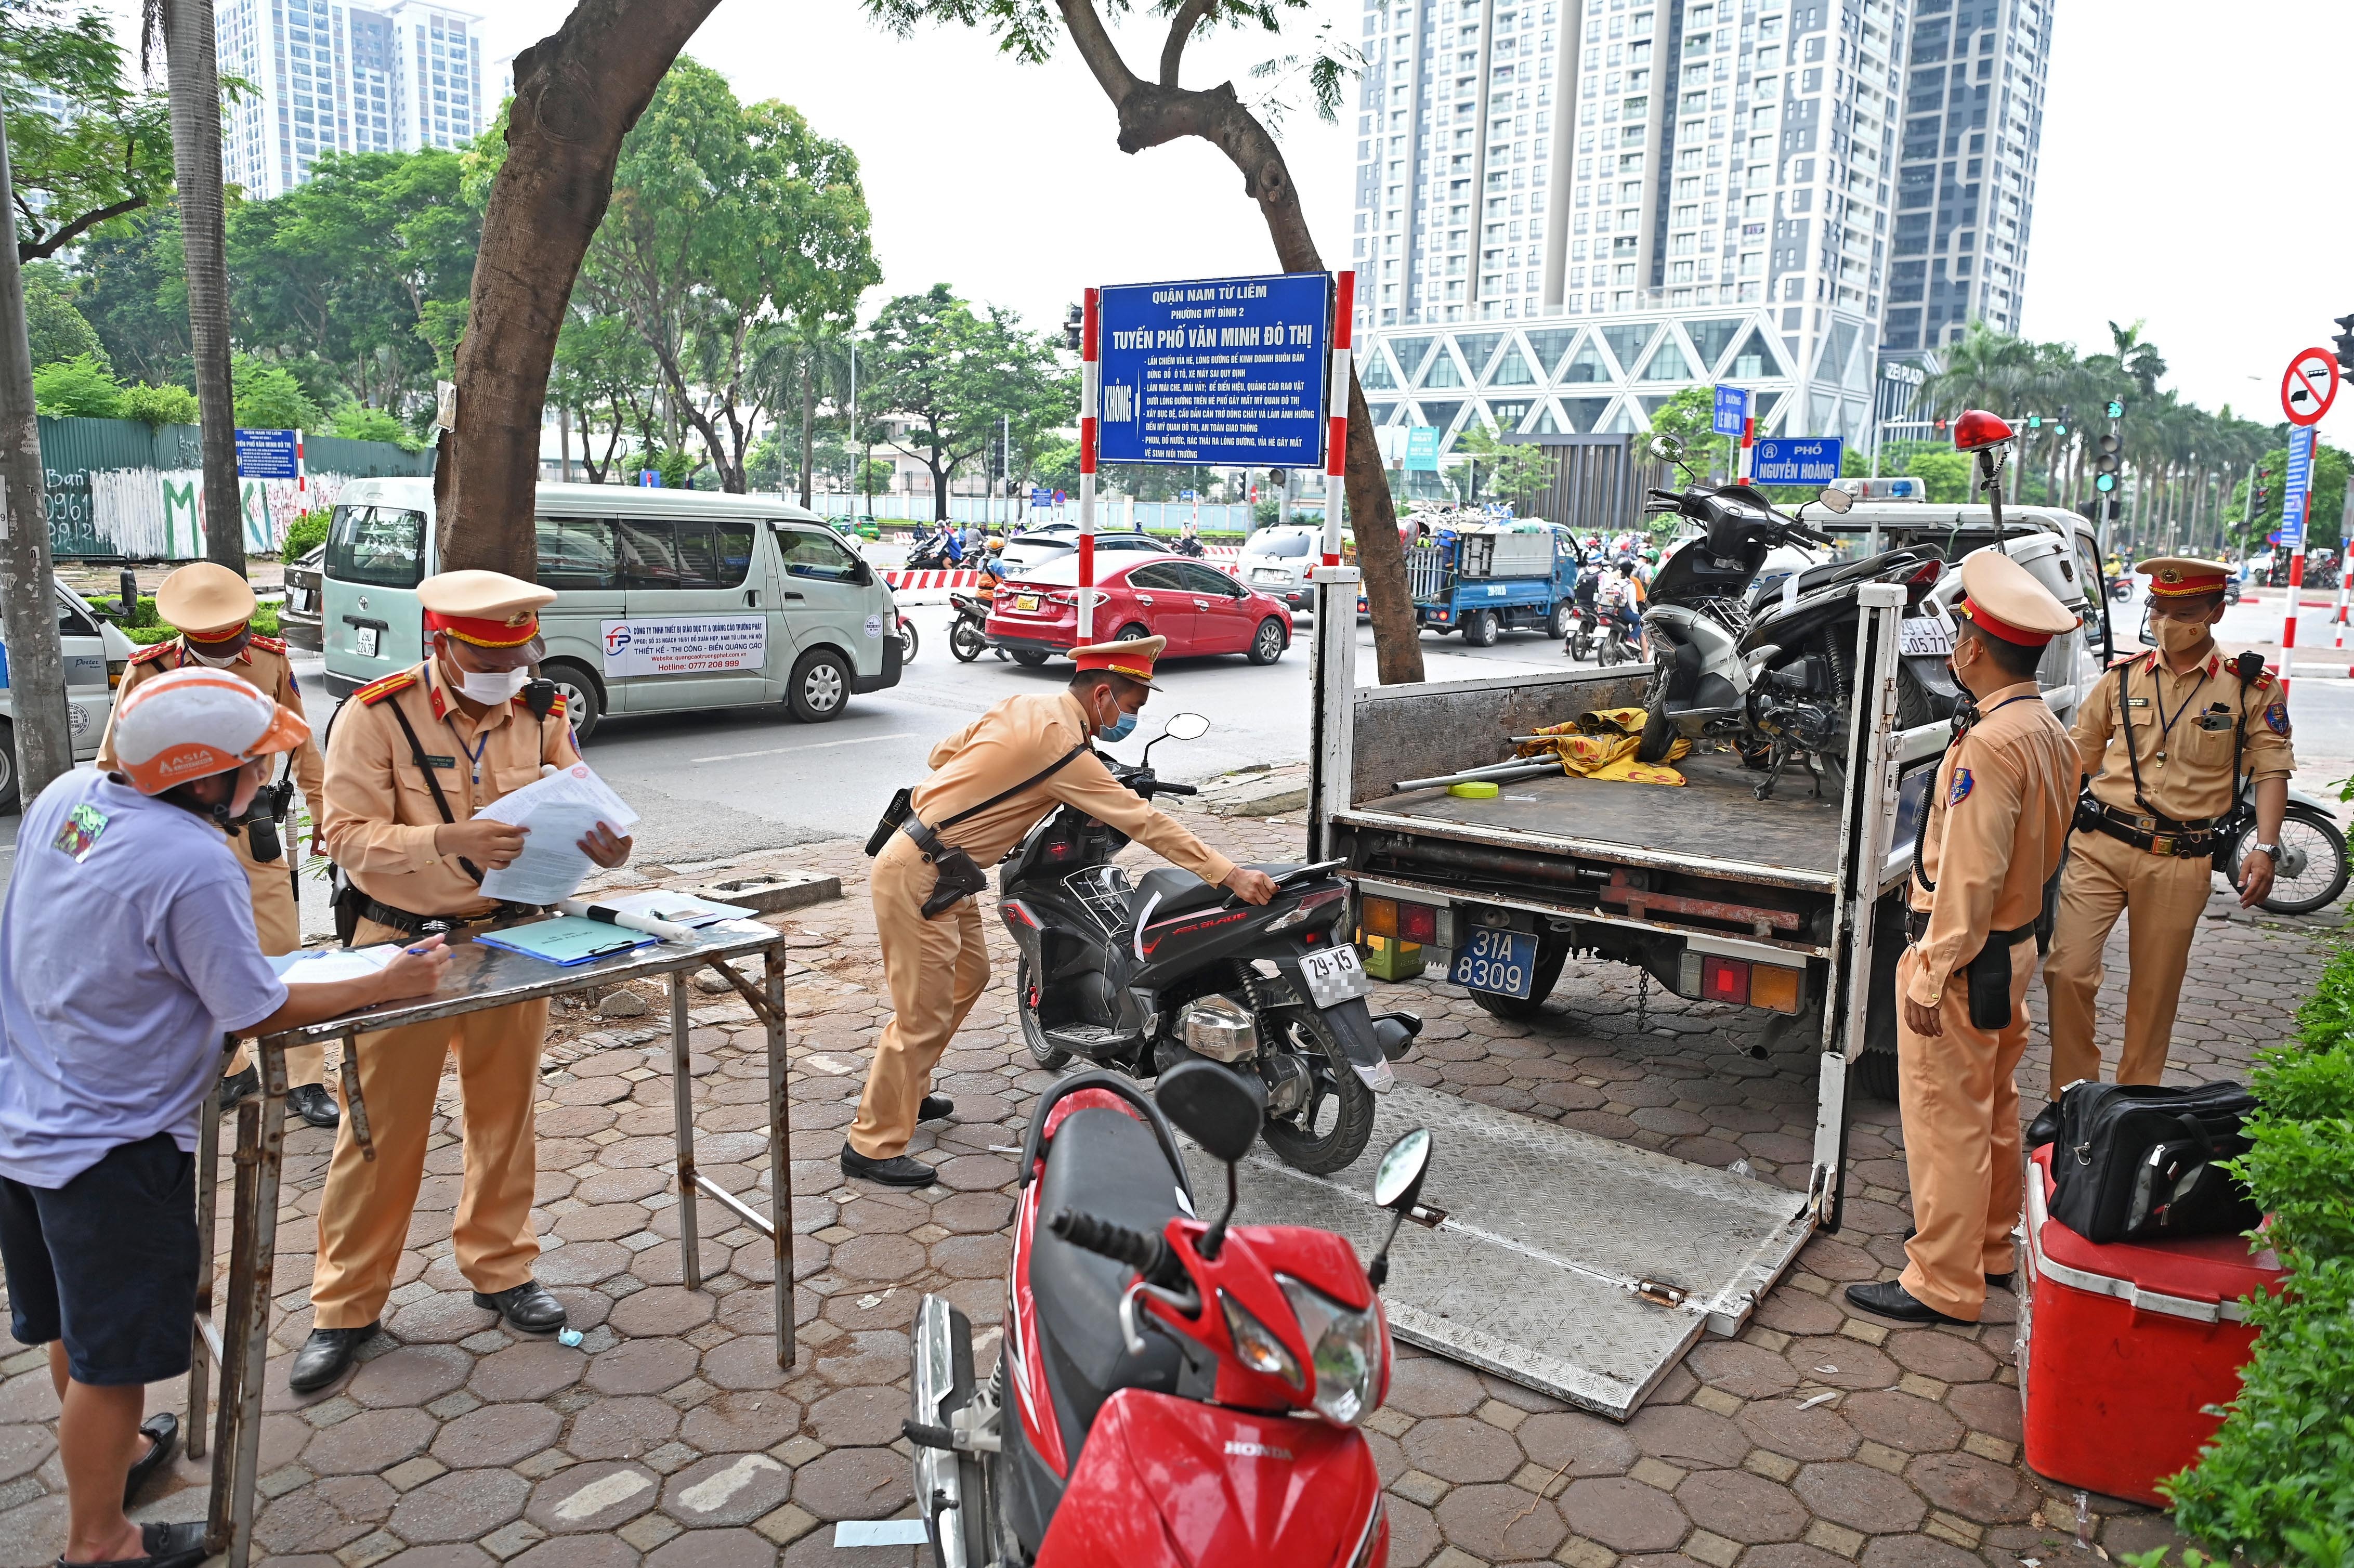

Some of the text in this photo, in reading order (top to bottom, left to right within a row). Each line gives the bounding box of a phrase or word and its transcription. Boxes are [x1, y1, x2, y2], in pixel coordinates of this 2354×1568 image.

[1152, 283, 1267, 306] QUẬN NAM TỪ LIÊM
[1171, 307, 1202, 320] PHƯỜNG
[1218, 305, 1237, 318] ĐÌNH
[1238, 307, 1244, 317] 2
[1113, 321, 1312, 350] TUYẾN PHỐ VĂN MINH ĐÔ THỊ
[1147, 355, 1158, 365] LẤN
[1158, 354, 1175, 365] CHIẾM
[1186, 354, 1195, 365] HÈ,
[1196, 354, 1210, 364] LÒNG
[1211, 353, 1230, 364] ĐƯỜNG
[1239, 355, 1253, 363] KINH
[1254, 354, 1274, 363] DOANH
[1275, 352, 1291, 362] BUÔN
[1292, 351, 1304, 362] BÁN
[1147, 369, 1161, 379] DỪNG
[1174, 369, 1179, 378] Ô
[1179, 368, 1187, 379] TÔ,
[1188, 370, 1196, 378] XE
[1196, 368, 1209, 378] MÁY
[1210, 369, 1219, 378] SAI
[1220, 369, 1231, 378] QUY
[1232, 369, 1246, 379] ĐỊNH
[1146, 382, 1158, 392] LÀM
[1159, 382, 1169, 392] MÁI
[1170, 383, 1182, 393] CHE,
[1183, 382, 1194, 391] MÁI
[1231, 381, 1246, 393] HIỆU,
[1247, 380, 1266, 392] QUẢNG
[1267, 380, 1279, 391] CÁO
[1280, 382, 1292, 390] RAO
[1293, 380, 1305, 393] VẶT
[1104, 377, 1132, 422] KHÔNG
[1146, 395, 1159, 406] DƯỚI
[1159, 395, 1173, 405] LÒNG
[1174, 395, 1192, 405] ĐƯỜNG
[1193, 395, 1207, 405] TRÊN
[1208, 395, 1215, 405] HÈ
[1216, 394, 1228, 405] PHỐ
[1228, 395, 1240, 405] GÂY
[1240, 394, 1253, 405] MẤT
[1264, 396, 1280, 406] QUAN
[1281, 394, 1289, 405] ĐÔ
[1290, 396, 1300, 407] THỊ
[1146, 408, 1156, 418] XÂY
[1157, 410, 1168, 420] BỤC
[1169, 408, 1177, 420] BỆ,
[1226, 408, 1241, 419] DÒNG
[1259, 408, 1266, 419] VÀ
[1267, 408, 1280, 419] LÀM
[1145, 421, 1156, 431] ĐẾN
[1166, 423, 1181, 432] QUAN
[1181, 421, 1189, 432] ĐÔ
[1190, 423, 1200, 434] THỊ,
[1201, 423, 1209, 432] AN
[1210, 422, 1224, 432] TOÀN
[1225, 424, 1238, 432] GIAO
[1239, 422, 1258, 433] THÔNG
[1145, 436, 1160, 445] PHUN,
[1170, 434, 1186, 446] NƯỚC,
[1186, 435, 1198, 445] RÁC
[1211, 437, 1219, 446] RA
[1220, 435, 1235, 446] LÒNG
[1236, 435, 1257, 447] ĐƯỜNG,
[1268, 436, 1276, 447] HÈ
[1277, 436, 1288, 447] GÂY
[1289, 436, 1302, 447] MẤT
[1145, 447, 1198, 459] VỆ SINH MÔI TRƯỜNG
[1794, 441, 1823, 455] PHỐ
[1759, 458, 1835, 480] NGUYỄN HOÀNG
[357, 642, 375, 655] 224.76
[1900, 637, 1947, 654] 505.77
[75, 658, 99, 668] Porter
[172, 750, 211, 765] ASIA
[1472, 930, 1513, 962] 31A
[1309, 949, 1353, 978] 29-X5
[1456, 956, 1523, 994] 8309
[1224, 1440, 1294, 1461] HONDA
